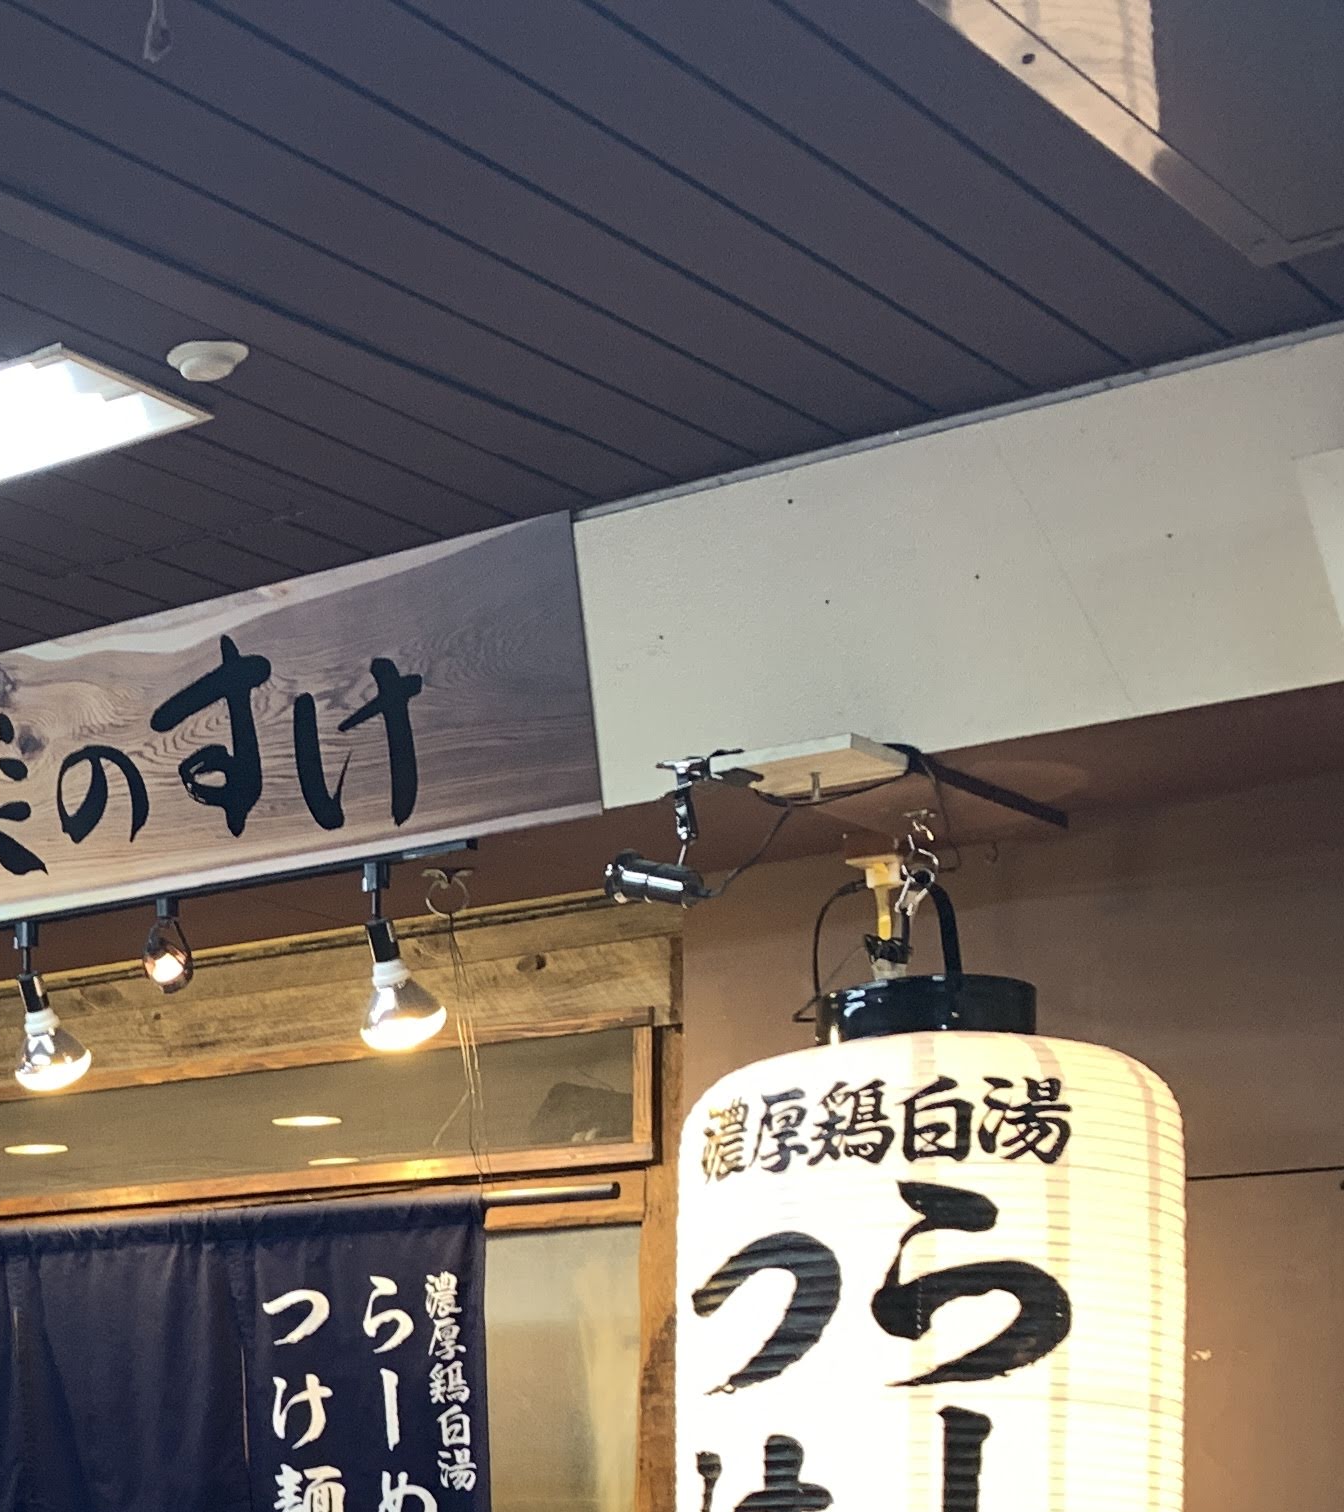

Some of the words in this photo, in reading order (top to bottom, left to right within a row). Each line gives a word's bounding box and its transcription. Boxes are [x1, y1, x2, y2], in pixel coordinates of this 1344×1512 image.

[701, 1076, 1074, 1185] 濃厚鶏白湯
[424, 1270, 478, 1492] 濃厚鶏白湯
